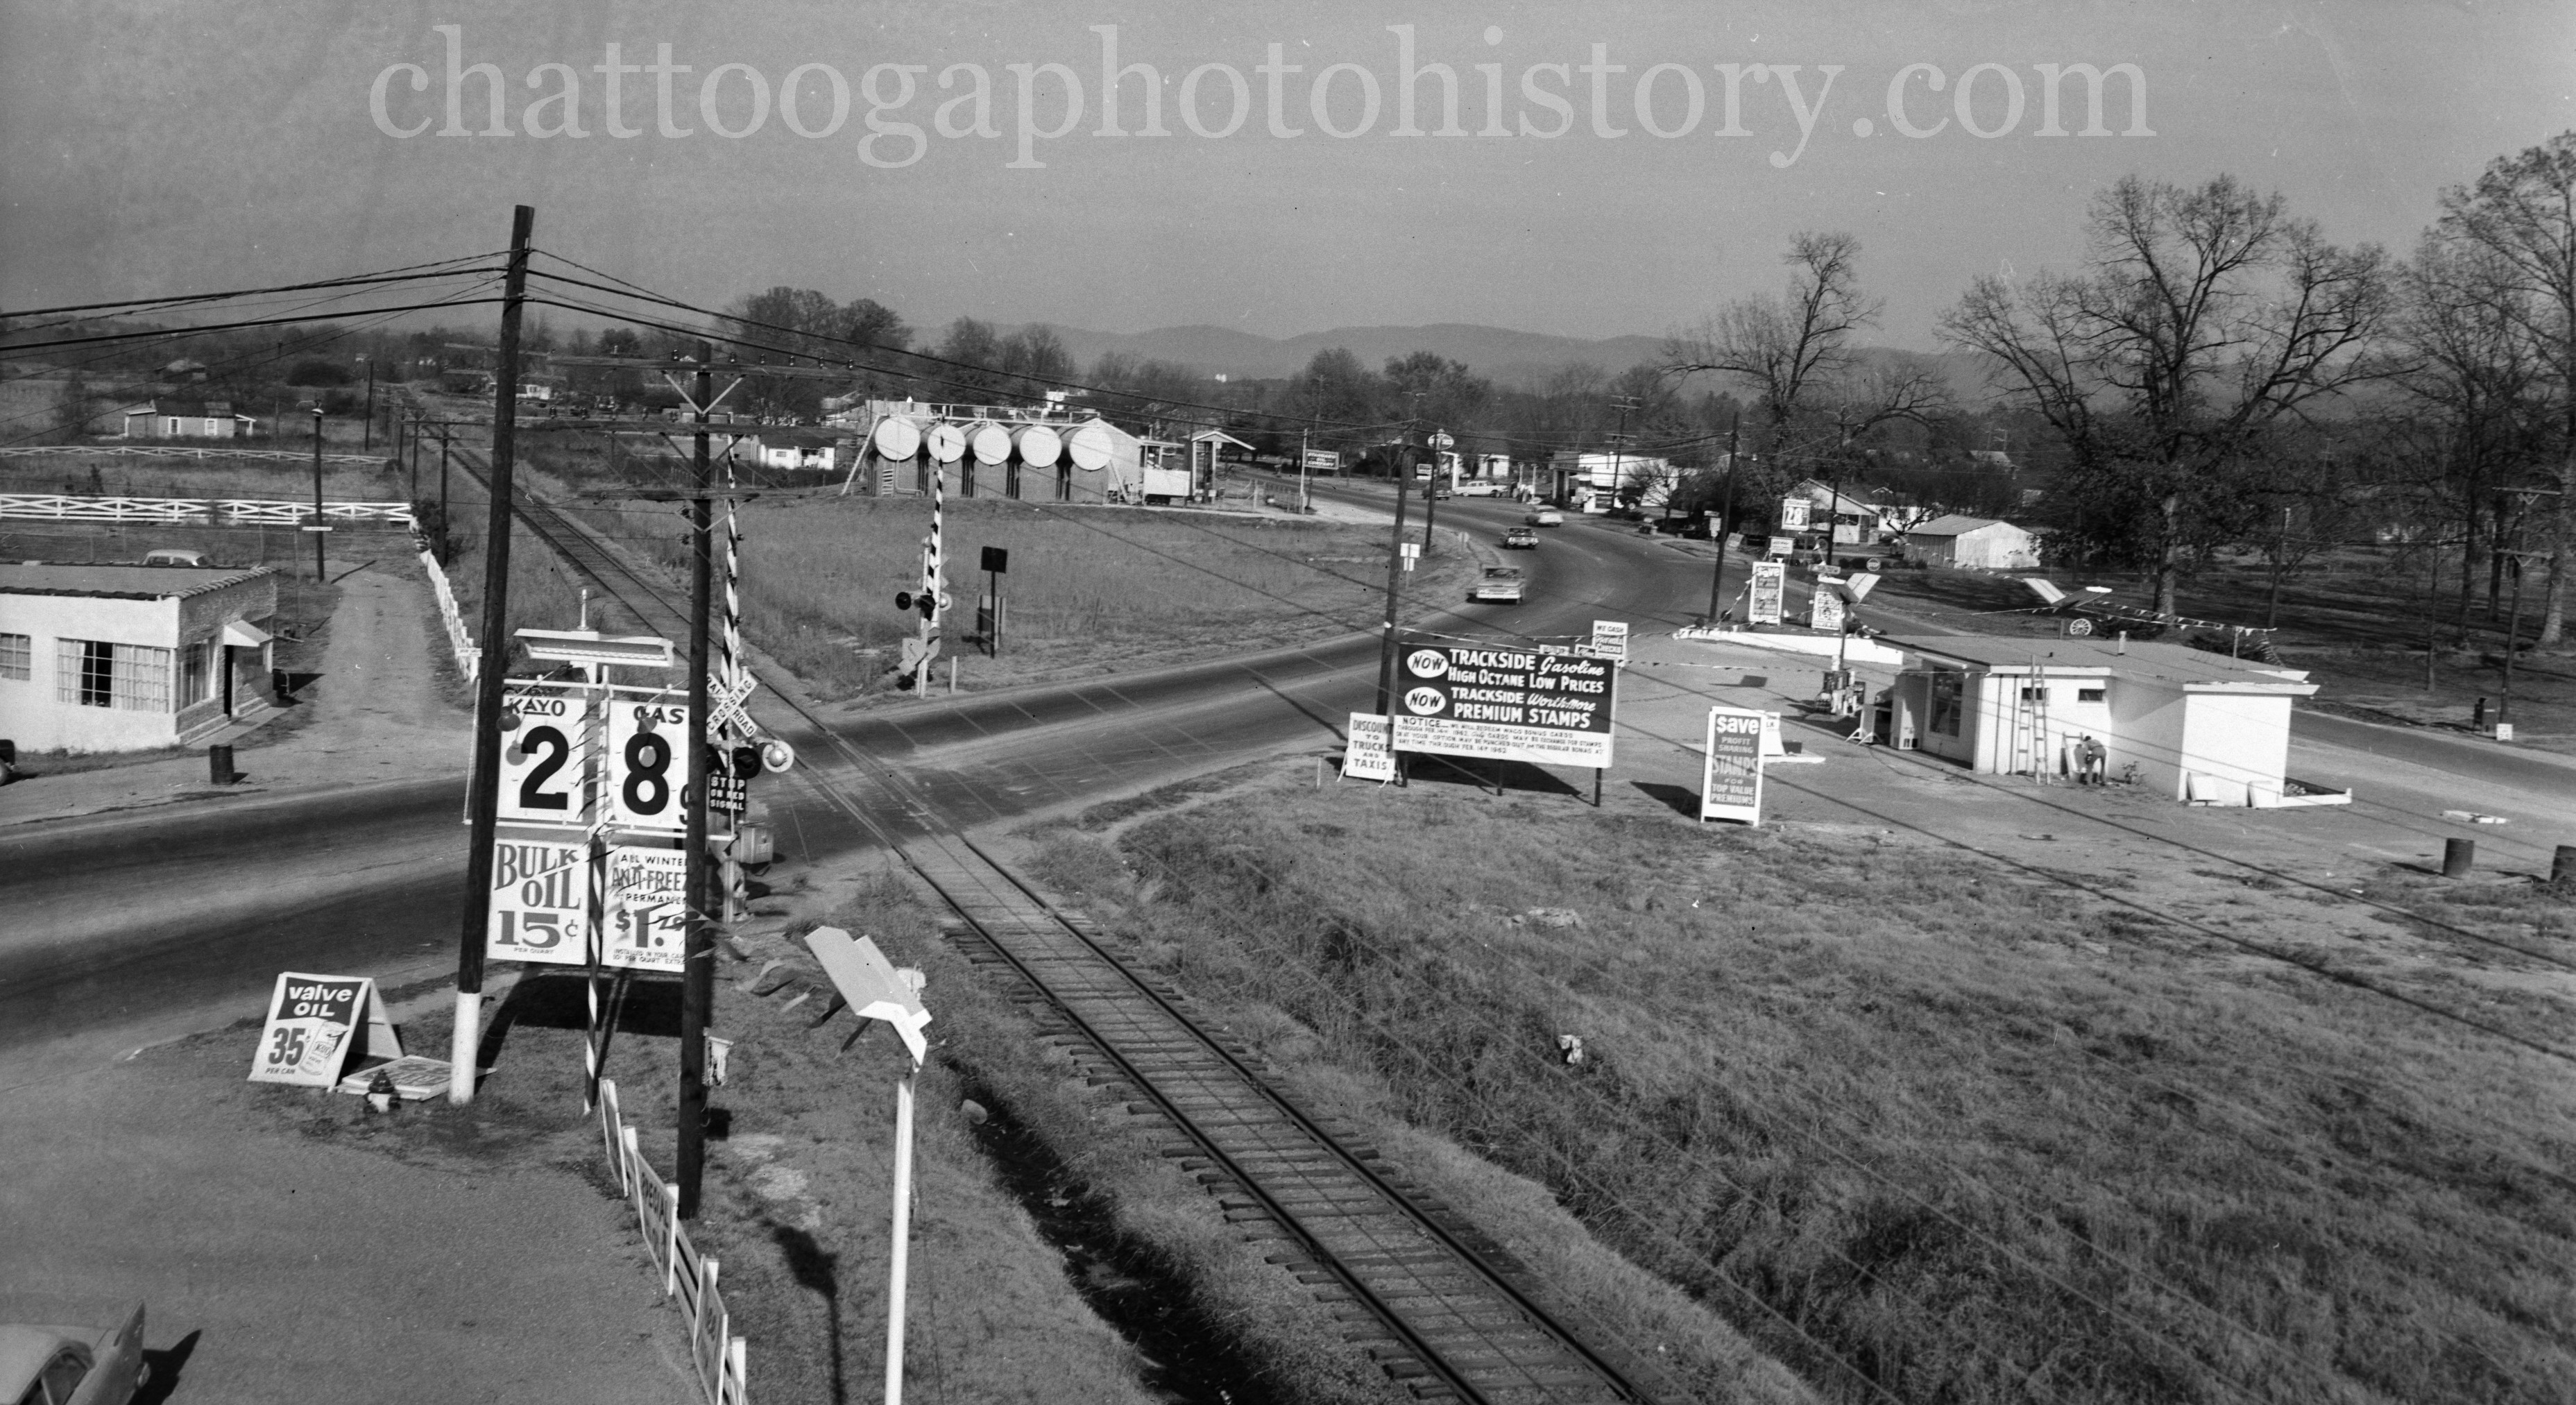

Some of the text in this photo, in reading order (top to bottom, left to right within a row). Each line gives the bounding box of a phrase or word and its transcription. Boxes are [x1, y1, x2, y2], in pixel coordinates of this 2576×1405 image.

[1411, 653, 1444, 671] NOW
[1449, 648, 1537, 671] TRACKSIDE
[1539, 656, 1606, 676] Gasoline
[1447, 666, 1605, 694] HIGH OCTANE LOW PRICES
[706, 680, 752, 731] CROSSING
[1408, 691, 1442, 708] NOW
[1450, 686, 1525, 705] TRACKSIDE
[508, 697, 566, 717] KAYO
[633, 705, 685, 725] GAS
[1453, 702, 1592, 729] PREMIUM STAMPS
[732, 708, 755, 735] ROAD
[1353, 739, 1391, 753] TRUCKS
[1718, 744, 1754, 754] SHARING
[1721, 735, 1751, 746] PROFIT
[519, 725, 570, 810] 2
[1354, 758, 1388, 770] TAXIS
[622, 732, 672, 816] 8
[710, 776, 746, 790] STOP
[710, 789, 745, 801] ON RED
[1711, 793, 1755, 805] PREMIUMS
[1712, 783, 1755, 796] TOP VALUE
[710, 799, 744, 811] SIGNAL
[494, 843, 579, 891] BULK
[620, 854, 683, 867] ALL WINTE
[522, 867, 581, 910] OIL
[289, 984, 353, 1002] valve
[293, 1002, 335, 1017] OIL
